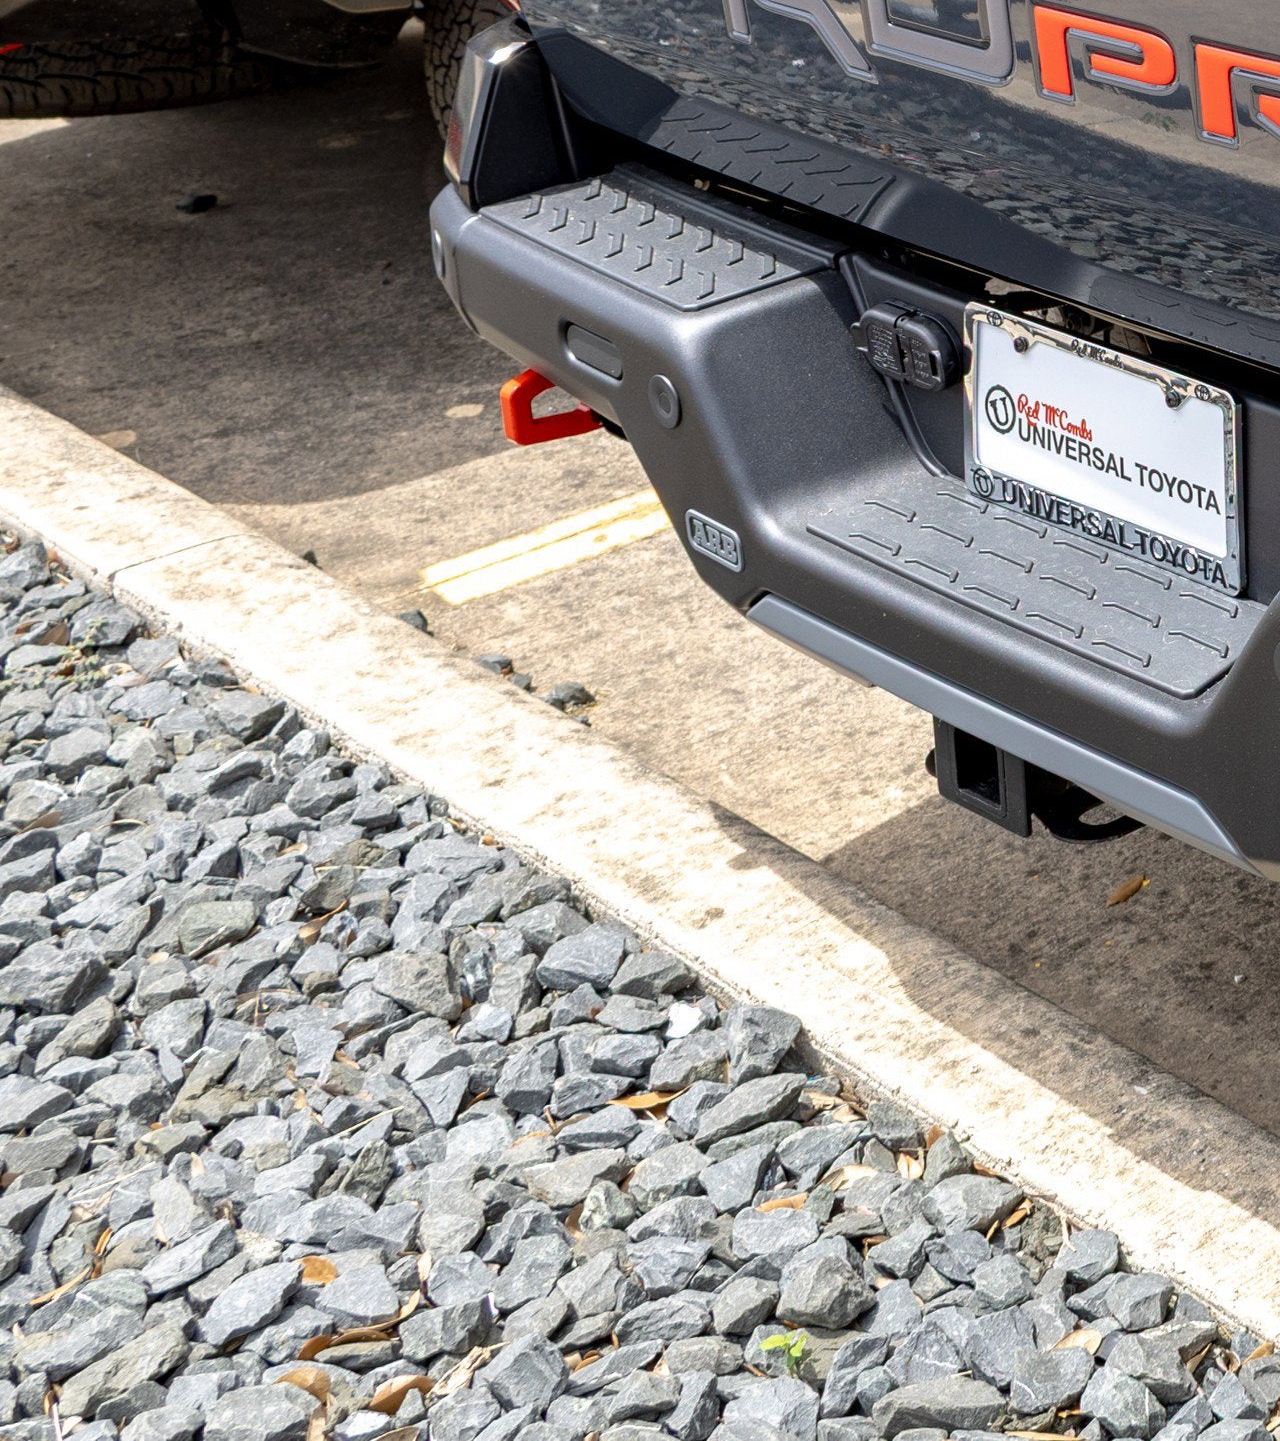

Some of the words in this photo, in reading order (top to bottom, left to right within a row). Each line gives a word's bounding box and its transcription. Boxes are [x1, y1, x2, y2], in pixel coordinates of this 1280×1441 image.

[1017, 393, 1041, 427] Red
[1042, 402, 1094, 442] McCombs
[1018, 417, 1133, 483] UNIVERSAL
[1135, 461, 1221, 515] TOYOTA
[692, 518, 737, 564] ARB
[1001, 477, 1135, 550] UNIVERSAL
[1134, 528, 1229, 588] TOYOTA
